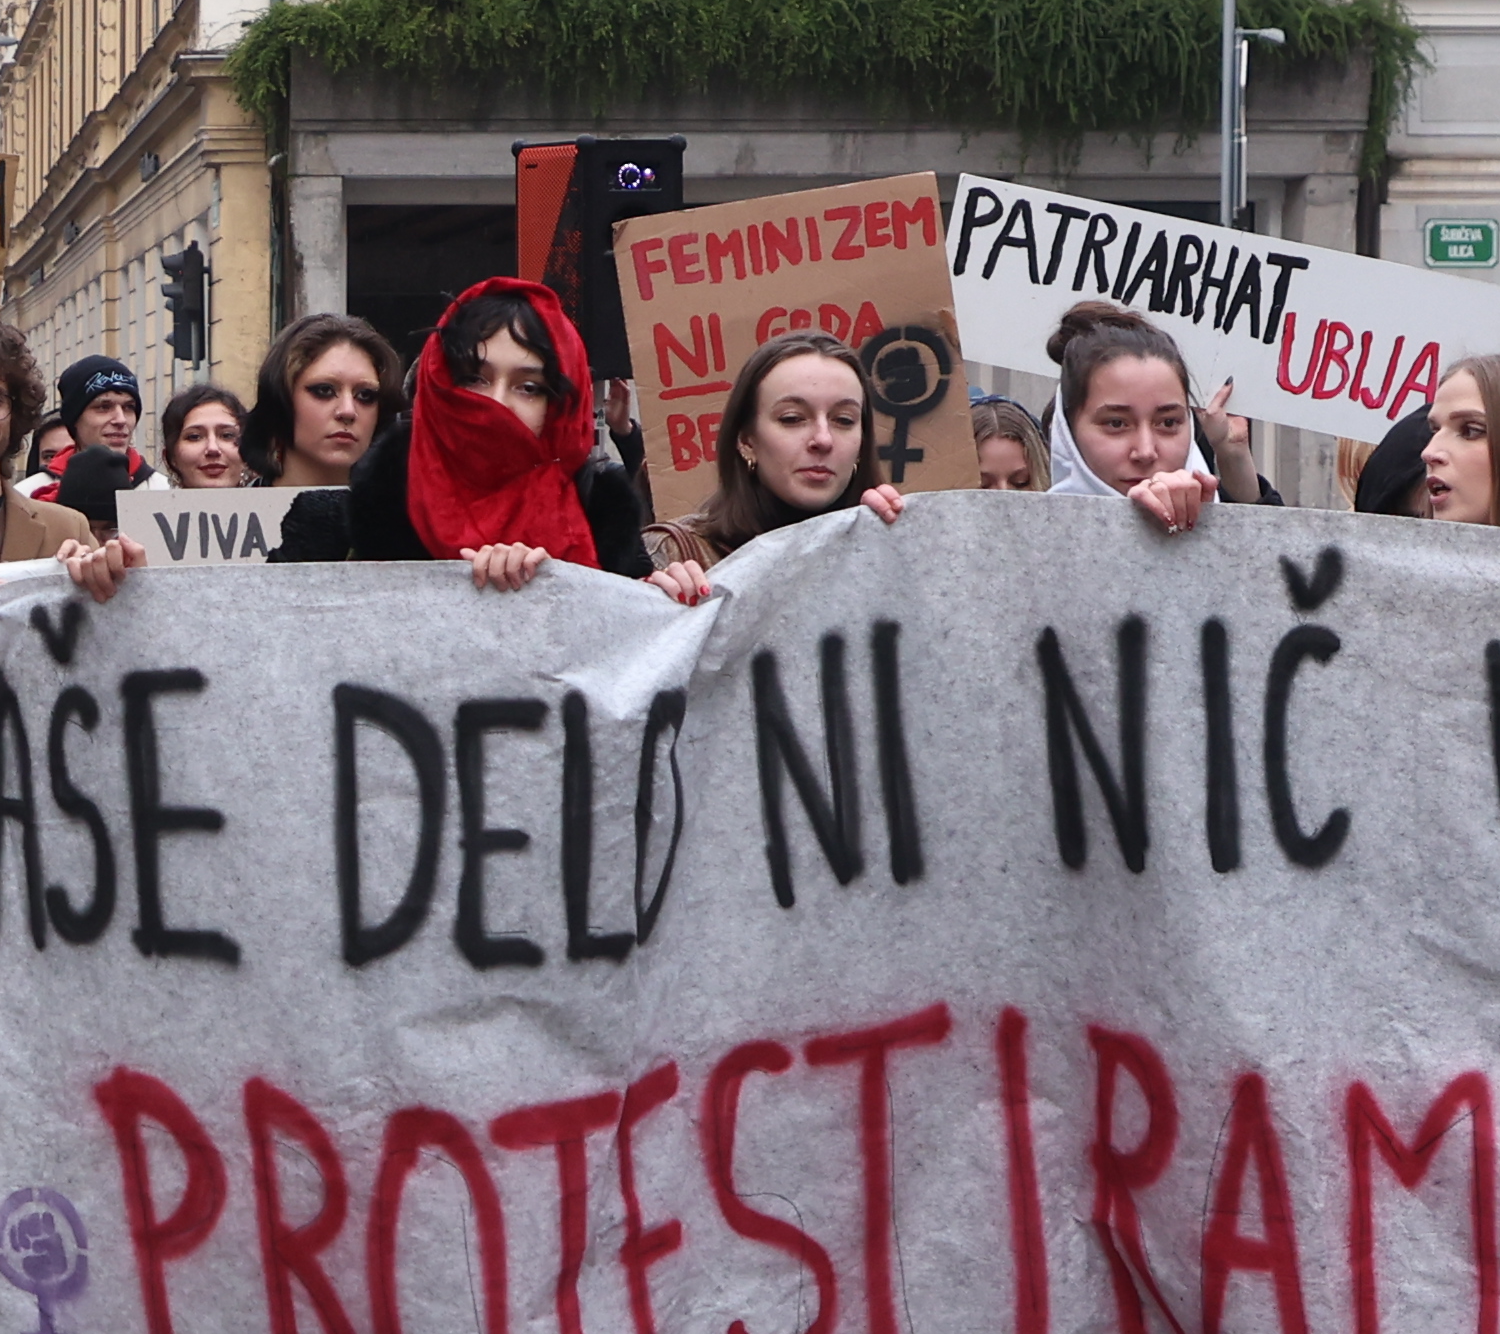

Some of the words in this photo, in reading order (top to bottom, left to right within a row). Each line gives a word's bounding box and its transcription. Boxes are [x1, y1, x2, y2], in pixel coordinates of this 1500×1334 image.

[630, 196, 937, 301] FEMINIZEM
[953, 187, 1309, 346] PATRIARHAT
[653, 312, 727, 388] NI
[1277, 311, 1441, 423] UBIJA
[152, 511, 268, 561] VIVA
[333, 683, 688, 966] DELO
[750, 619, 925, 907] NI
[1036, 545, 1352, 874] NIČ
